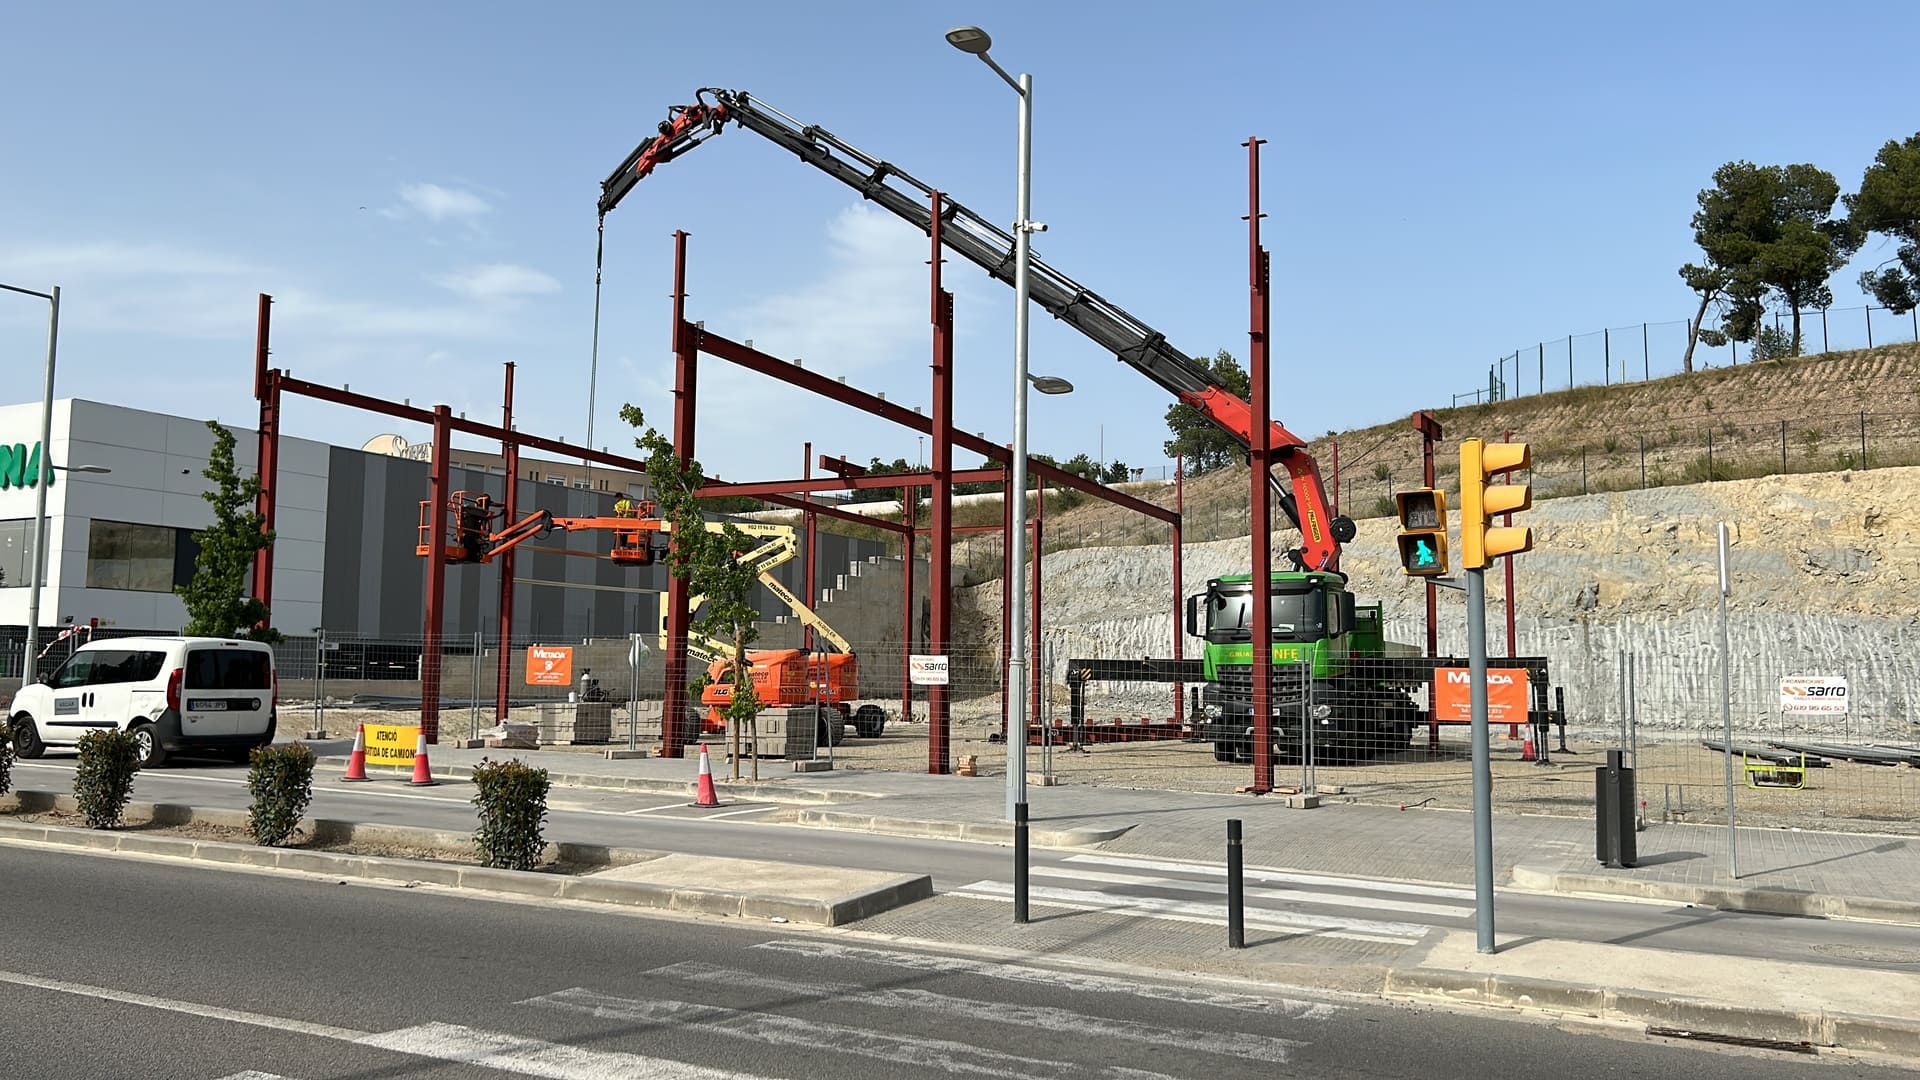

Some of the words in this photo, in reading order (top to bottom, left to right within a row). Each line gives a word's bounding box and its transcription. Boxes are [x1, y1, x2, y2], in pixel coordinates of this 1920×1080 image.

[768, 582, 793, 603] mateco
[1274, 649, 1298, 660] NFE
[924, 662, 948, 671] sarro
[1807, 687, 1846, 696] sarro
[382, 748, 389, 757] DE
